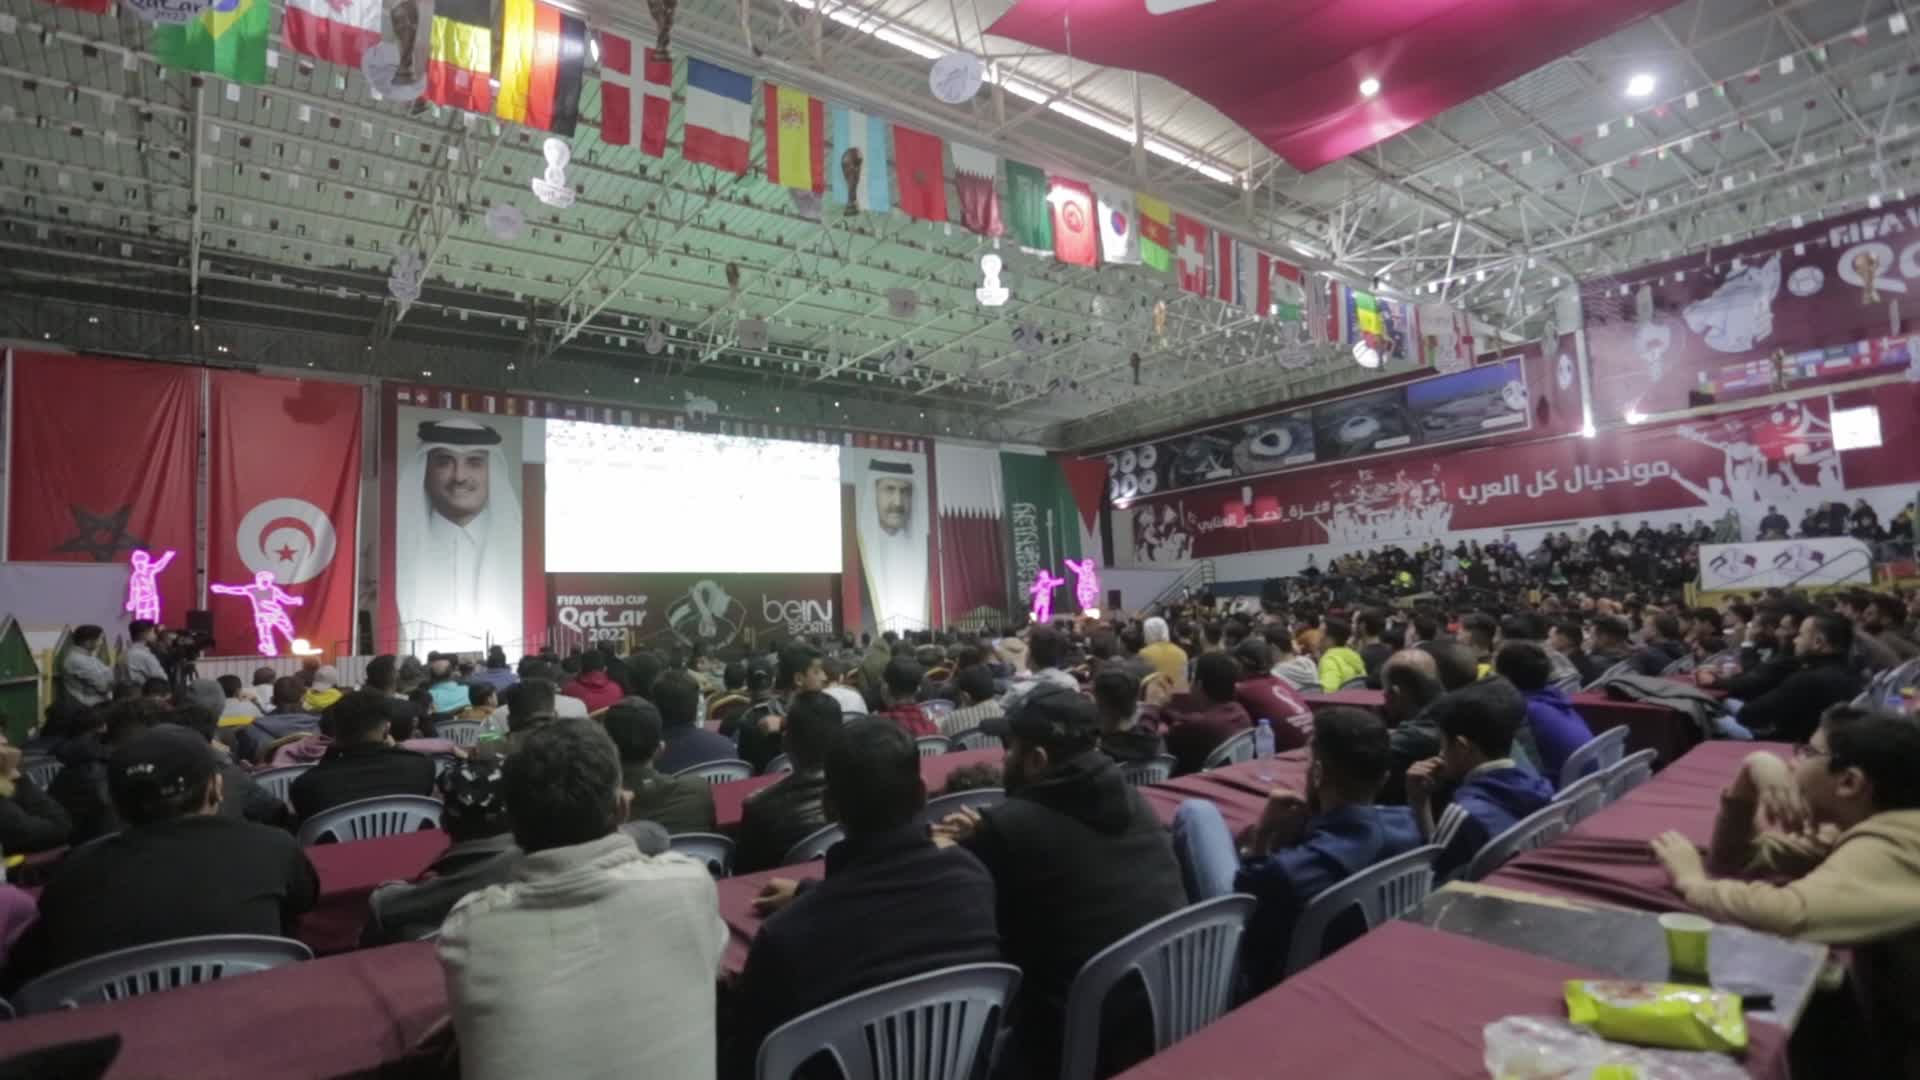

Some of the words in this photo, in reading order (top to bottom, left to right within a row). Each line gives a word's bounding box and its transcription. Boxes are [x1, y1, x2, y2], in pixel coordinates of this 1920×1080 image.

[1829, 212, 1905, 248] FIFA
[1457, 474, 1520, 505] العرب
[1525, 469, 1558, 499] كل
[1564, 459, 1670, 495] مونديال
[557, 594, 584, 606] FIFA
[584, 594, 625, 606] WORLD
[625, 594, 649, 605] CUP
[558, 606, 648, 634] Qatar
[590, 627, 629, 642] 2022
